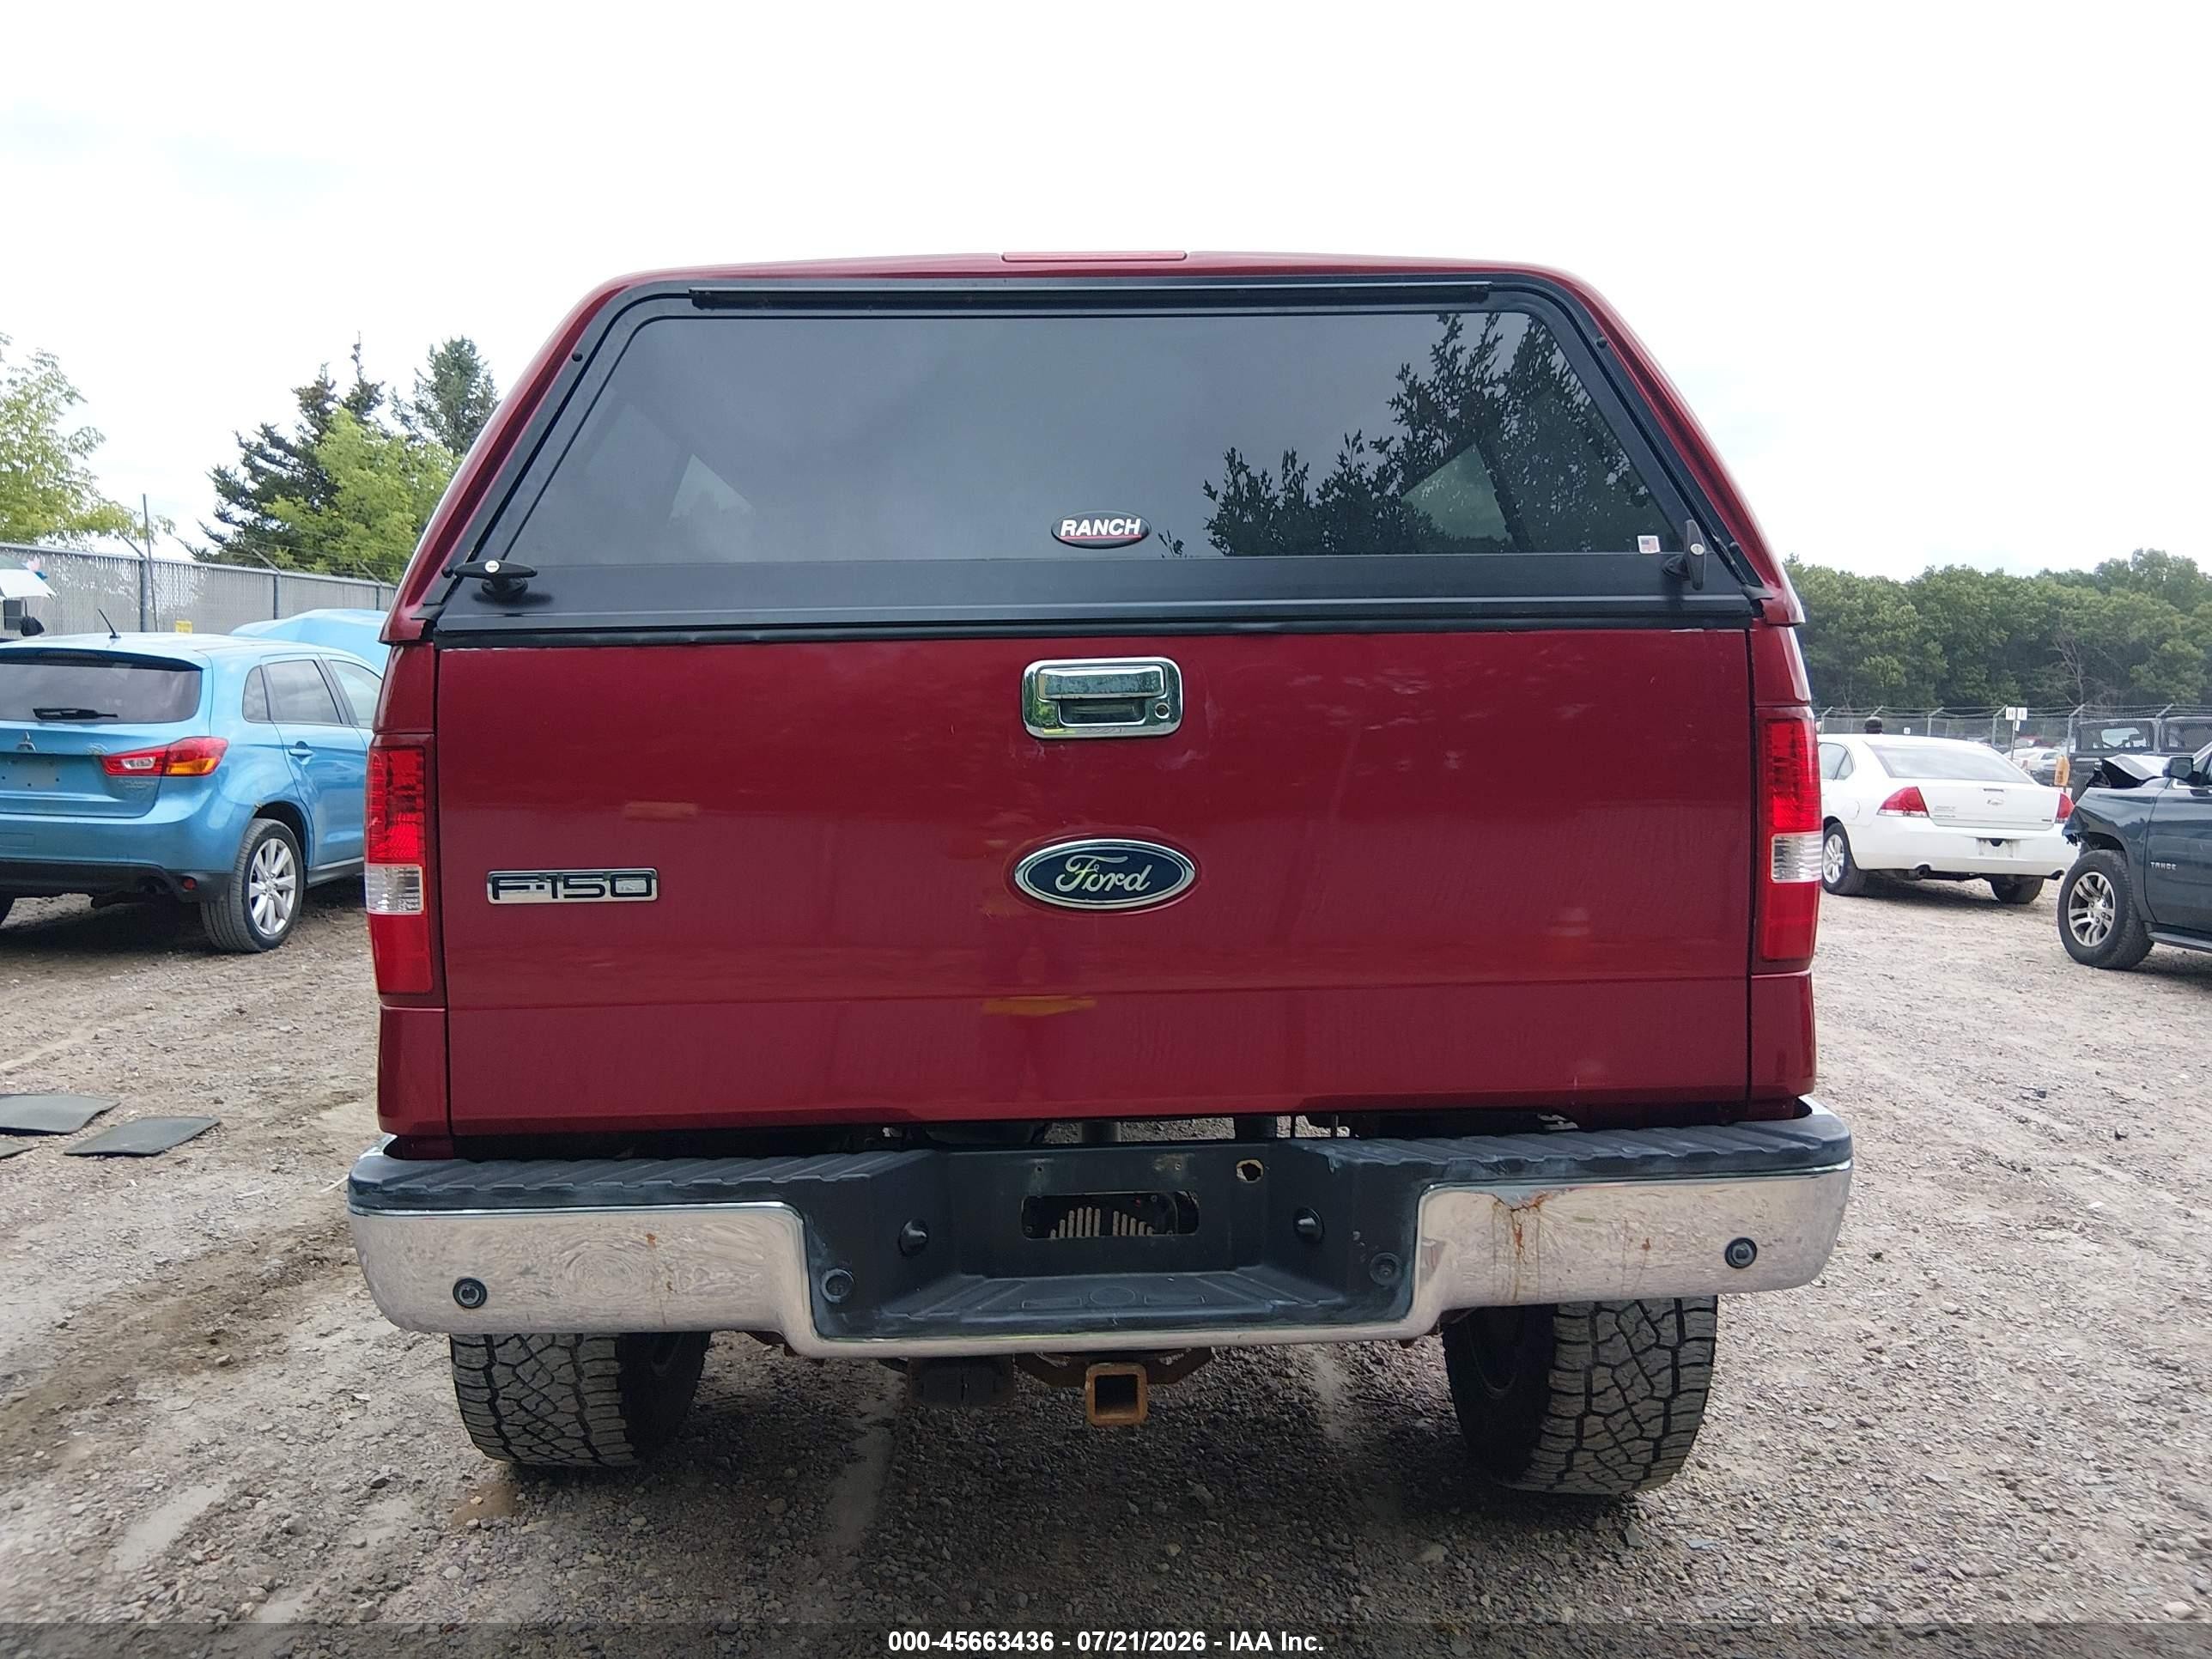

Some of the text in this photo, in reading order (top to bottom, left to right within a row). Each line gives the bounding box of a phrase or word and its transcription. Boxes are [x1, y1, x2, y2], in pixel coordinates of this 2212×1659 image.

[1060, 518, 1141, 537] RANCH
[491, 872, 653, 901] F-150
[1054, 854, 1152, 893] Ford
